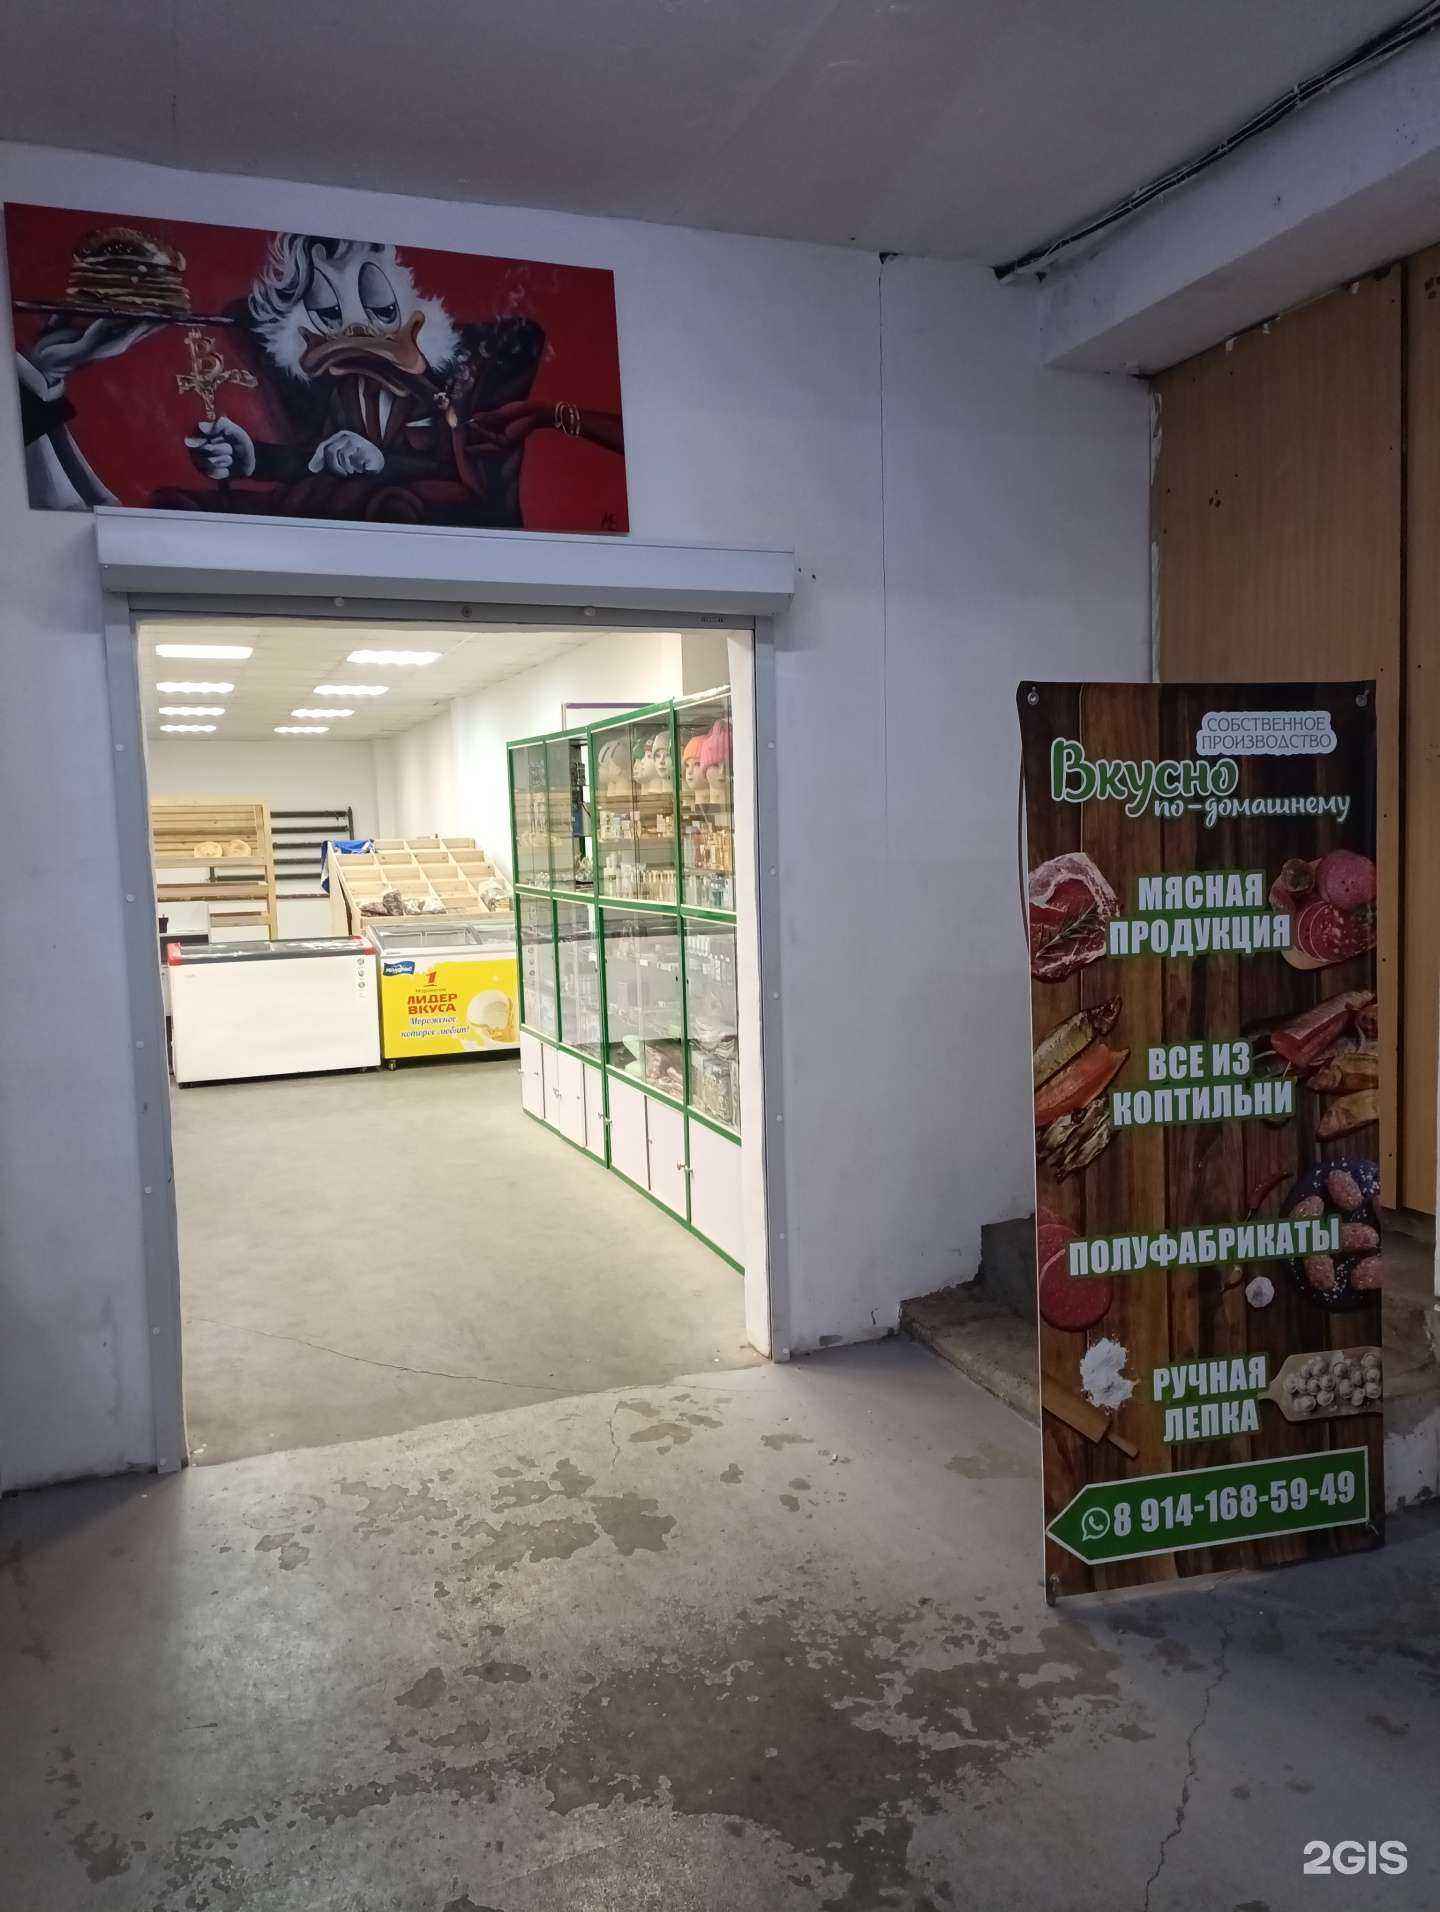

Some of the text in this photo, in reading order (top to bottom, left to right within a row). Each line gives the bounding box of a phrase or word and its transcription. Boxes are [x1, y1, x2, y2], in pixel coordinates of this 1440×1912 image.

[1202, 733, 1332, 749] ПРОИЗВОДСТВО
[1207, 717, 1326, 732] СОБСТВЕННОЕ
[1050, 737, 1238, 817] Вкусно
[1154, 795, 1350, 829] по-домашнему
[1138, 873, 1264, 911] МЯСНАЯ
[1109, 914, 1291, 957] ПРОДУКЦИЯ
[408, 994, 457, 1005] ЛИДЕР
[408, 1004, 456, 1014] ВКУСА
[1148, 1042, 1251, 1081] ВСЕ ИЗ
[1113, 1081, 1293, 1126] КОПТИЛЬНИ
[1069, 1218, 1340, 1277] ПОЛУФАБРИКАТЫ
[1153, 1356, 1267, 1401] РУЧНАЯ
[1163, 1399, 1260, 1442] ЛЕПКА
[1113, 1470, 1356, 1537] 8 914-168-59-49
